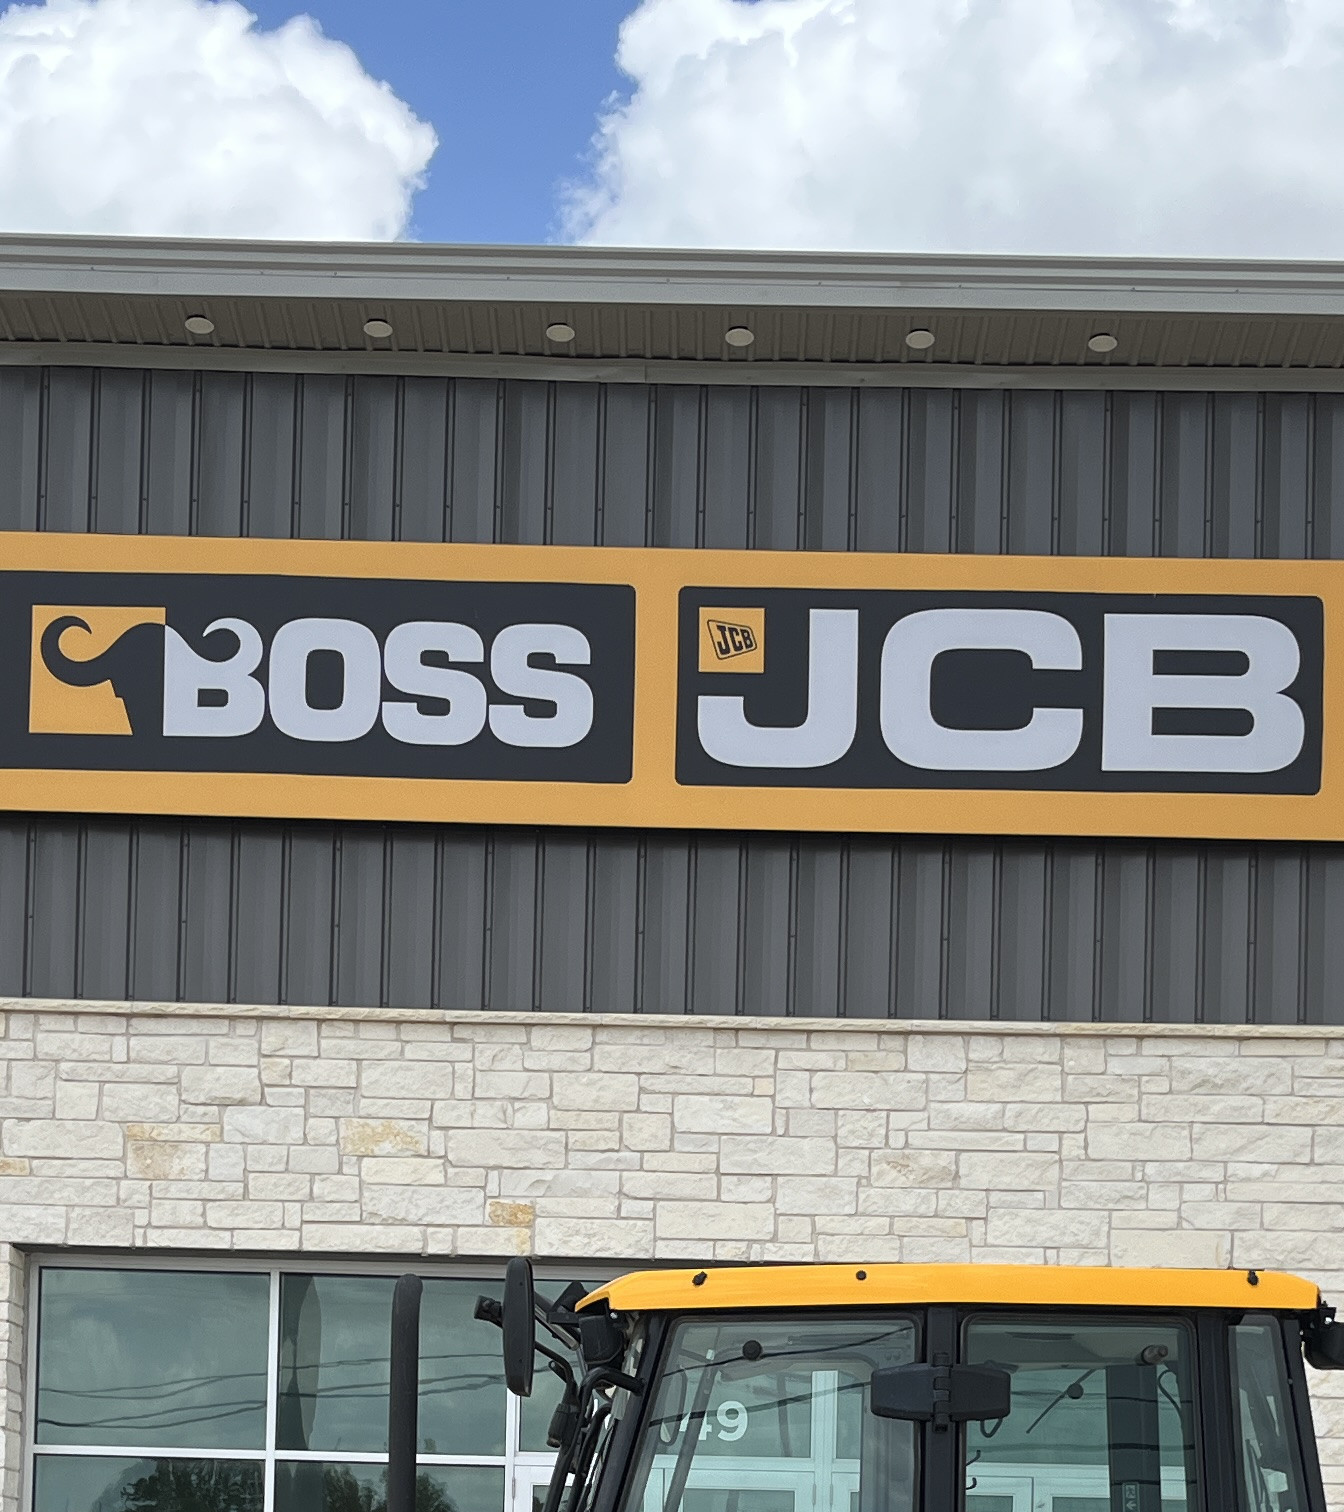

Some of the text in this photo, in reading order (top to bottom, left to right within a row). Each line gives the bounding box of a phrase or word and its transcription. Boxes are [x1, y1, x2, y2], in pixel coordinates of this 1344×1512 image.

[163, 616, 594, 748] BOSS
[697, 608, 1306, 773] JCB
[716, 624, 754, 655] JCB
